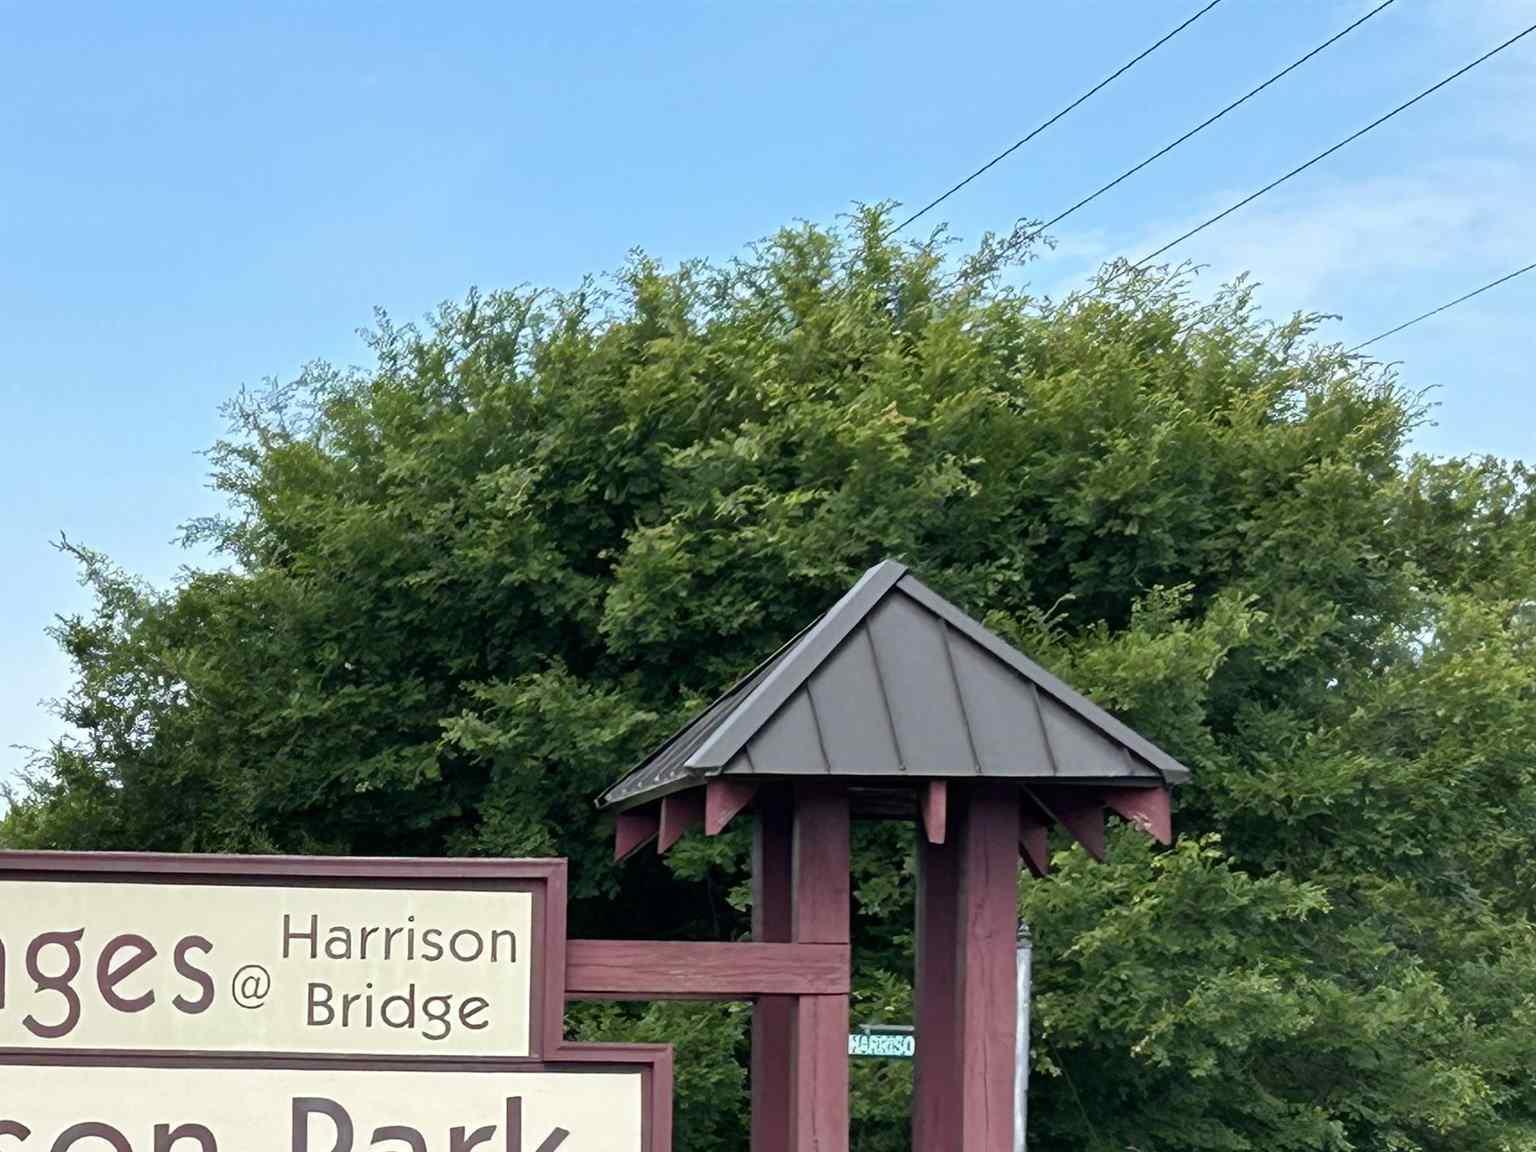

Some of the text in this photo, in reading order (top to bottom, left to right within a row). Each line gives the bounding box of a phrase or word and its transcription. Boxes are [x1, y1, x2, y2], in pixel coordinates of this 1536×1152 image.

[281, 913, 517, 963] Harrison
[231, 963, 272, 1010] @
[306, 982, 491, 1041] Bridge
